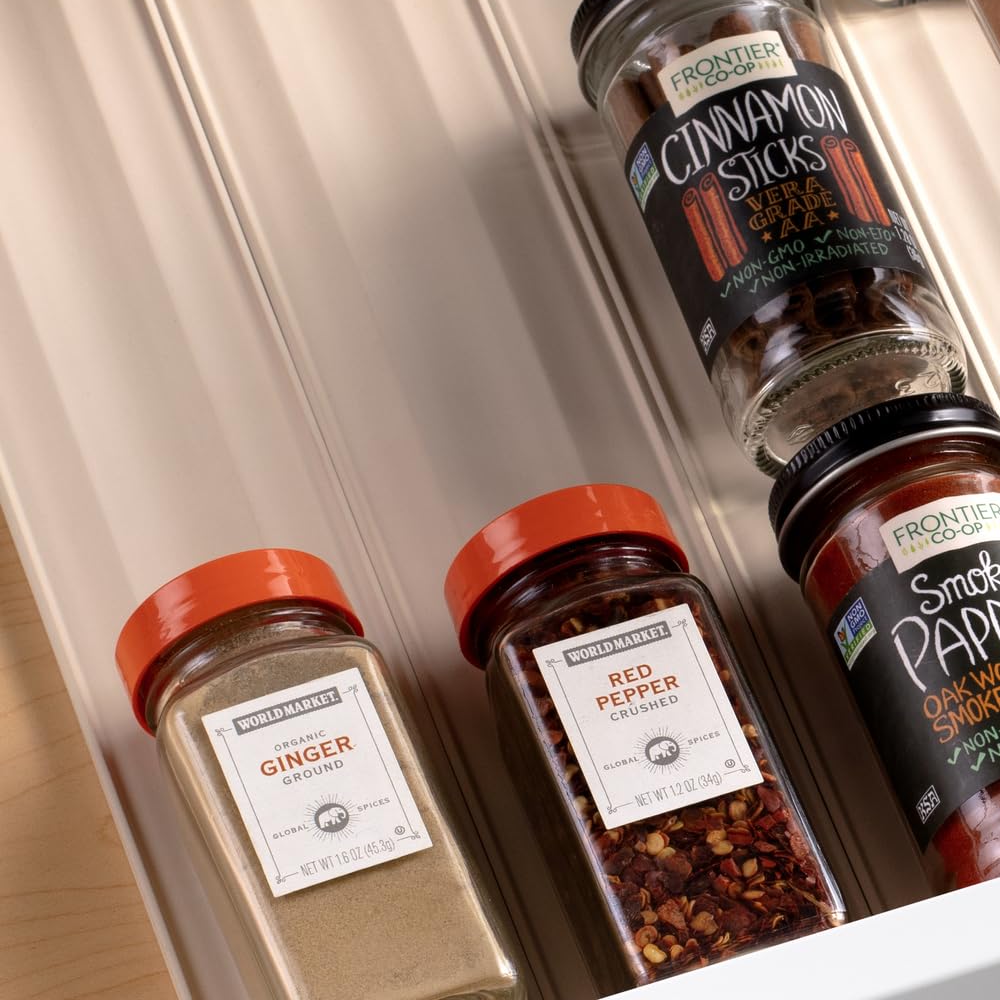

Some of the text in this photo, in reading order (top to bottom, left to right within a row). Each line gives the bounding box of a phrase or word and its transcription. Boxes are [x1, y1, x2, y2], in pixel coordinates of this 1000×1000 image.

[671, 42, 779, 92] FRONTIER
[704, 62, 755, 87] CO-OP
[660, 83, 848, 185] CINNAMON
[716, 135, 827, 202] STICKS
[745, 176, 825, 211] VERA
[748, 190, 838, 232] GRADE
[732, 239, 805, 289] NON-GMO
[761, 242, 889, 288] NON-IRRADIATED
[931, 522, 983, 545] CO-OP
[847, 602, 862, 622] NON
[850, 609, 865, 629] GMO
[608, 663, 653, 688] RED
[595, 675, 680, 711] PEPPER
[610, 694, 679, 722] CRUSHED
[922, 672, 973, 719] OAK
[274, 729, 327, 752] ORGANIC
[687, 731, 721, 746] SPICES
[260, 735, 354, 777] GINGER
[603, 756, 639, 771] GLOBAL
[282, 759, 344, 786] GROUND
[634, 770, 723, 808] NET WT 1.2 OZ (34g)
[356, 797, 391, 813] SPICES
[272, 823, 309, 840] GLOBAL
[300, 838, 396, 877] NET WT 1.6 OZ (45.3g)
